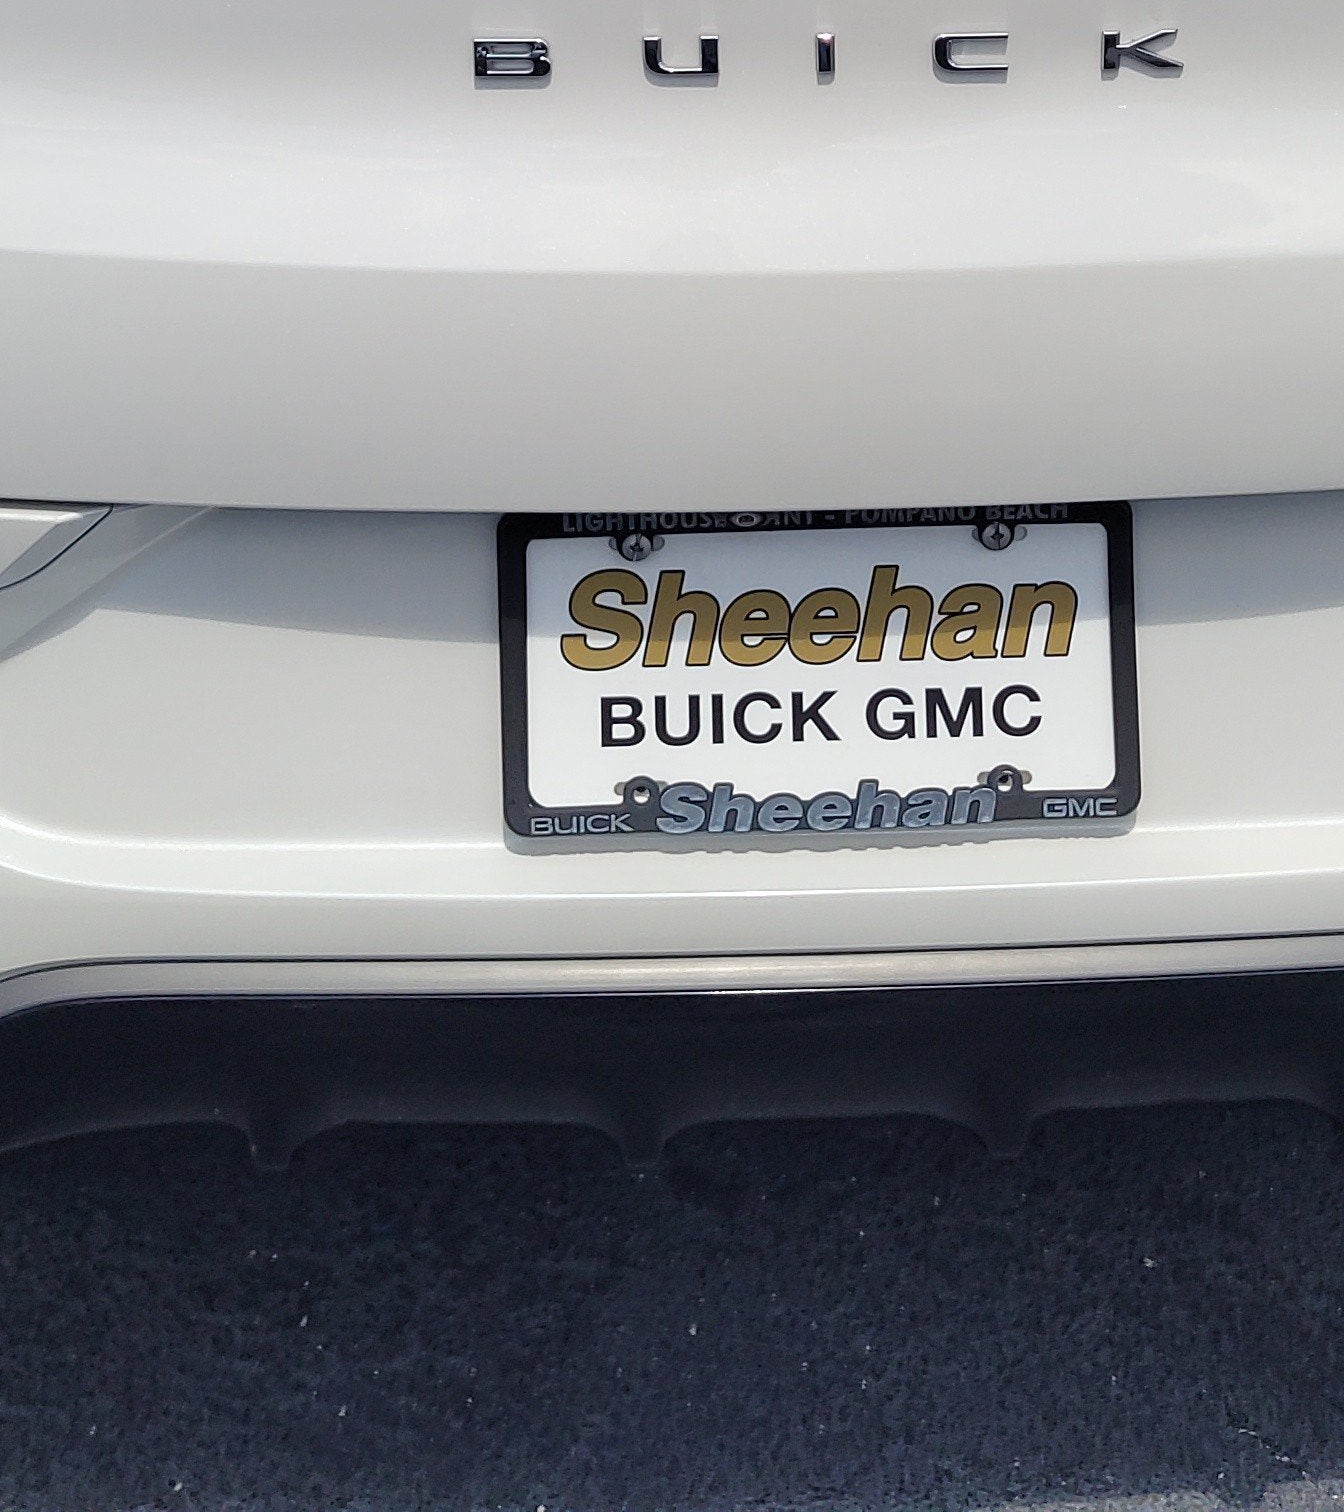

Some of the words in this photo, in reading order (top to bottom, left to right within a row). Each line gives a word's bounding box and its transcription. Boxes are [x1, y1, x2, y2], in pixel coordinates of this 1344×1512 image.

[474, 28, 1184, 78] BUICK
[985, 503, 1068, 520] BEACH
[561, 565, 1078, 671] Sheehan
[599, 690, 841, 748] BUICK
[865, 684, 1043, 740] GMC
[529, 813, 635, 835] BUICK
[656, 779, 997, 835] Sheehan
[1041, 797, 1118, 818] GMC
